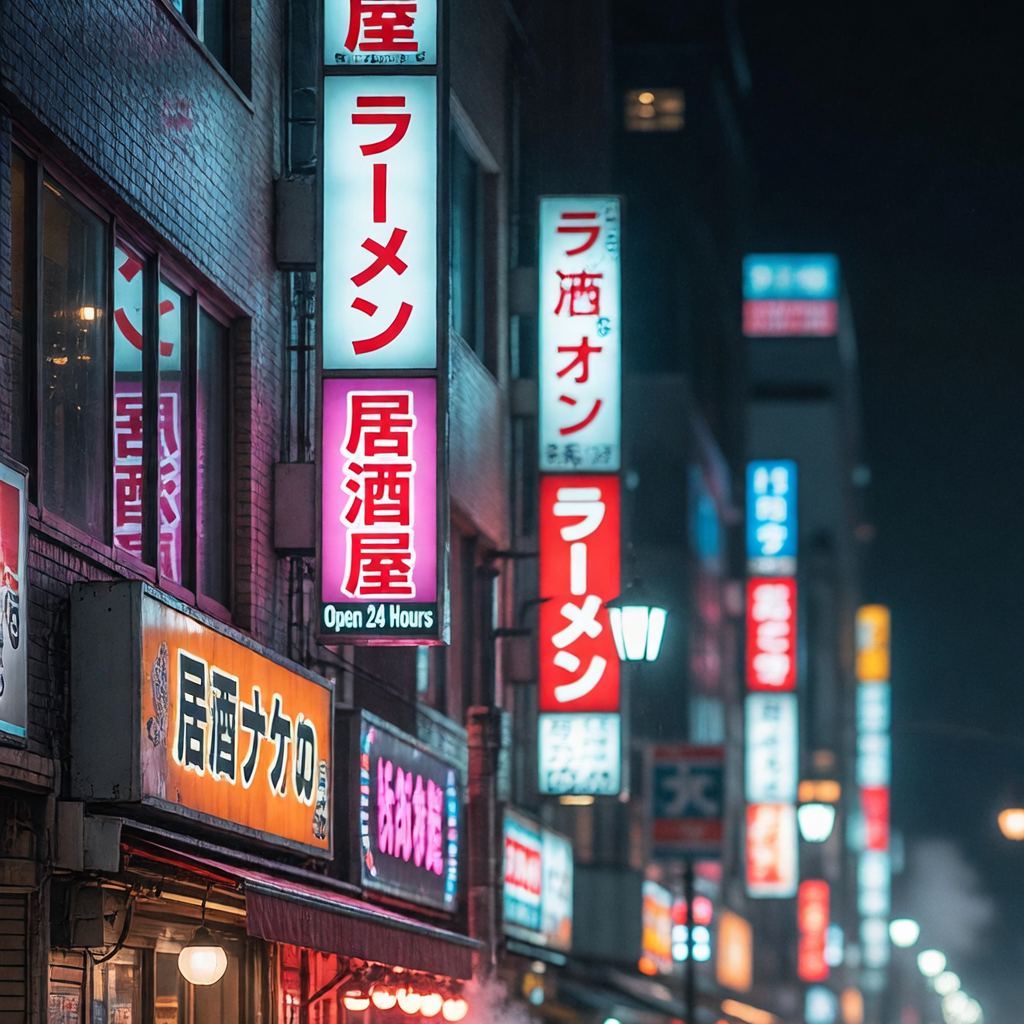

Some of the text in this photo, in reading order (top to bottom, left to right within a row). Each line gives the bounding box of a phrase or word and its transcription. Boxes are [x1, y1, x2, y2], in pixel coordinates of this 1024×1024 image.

[351, 97, 412, 355] ラーメン
[342, 390, 417, 600] 居酒屋
[551, 487, 607, 703] ラーメン
[324, 605, 434, 633] Open 24 Hours
